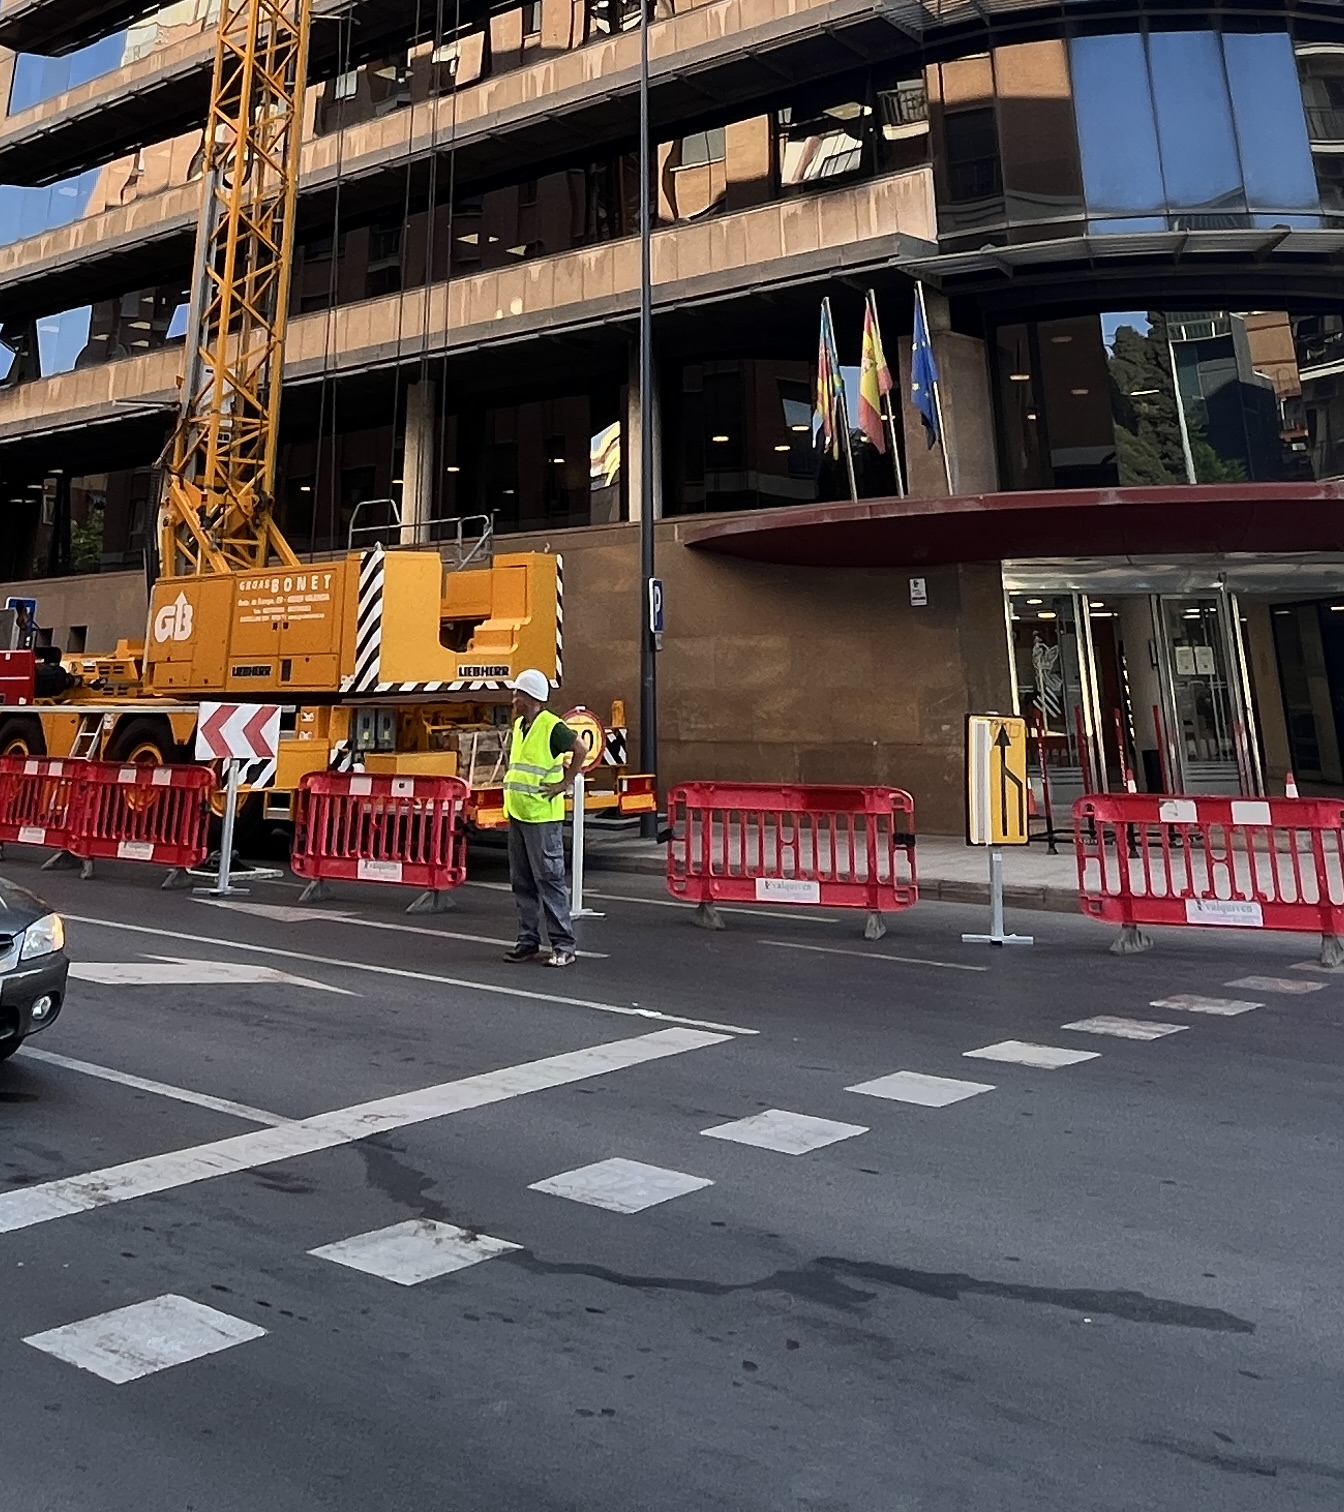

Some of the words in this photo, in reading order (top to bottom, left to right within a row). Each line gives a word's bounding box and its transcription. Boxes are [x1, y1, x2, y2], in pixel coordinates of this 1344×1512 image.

[271, 574, 332, 593] BONET
[654, 585, 662, 626] P
[458, 665, 509, 678] LIEBHERR
